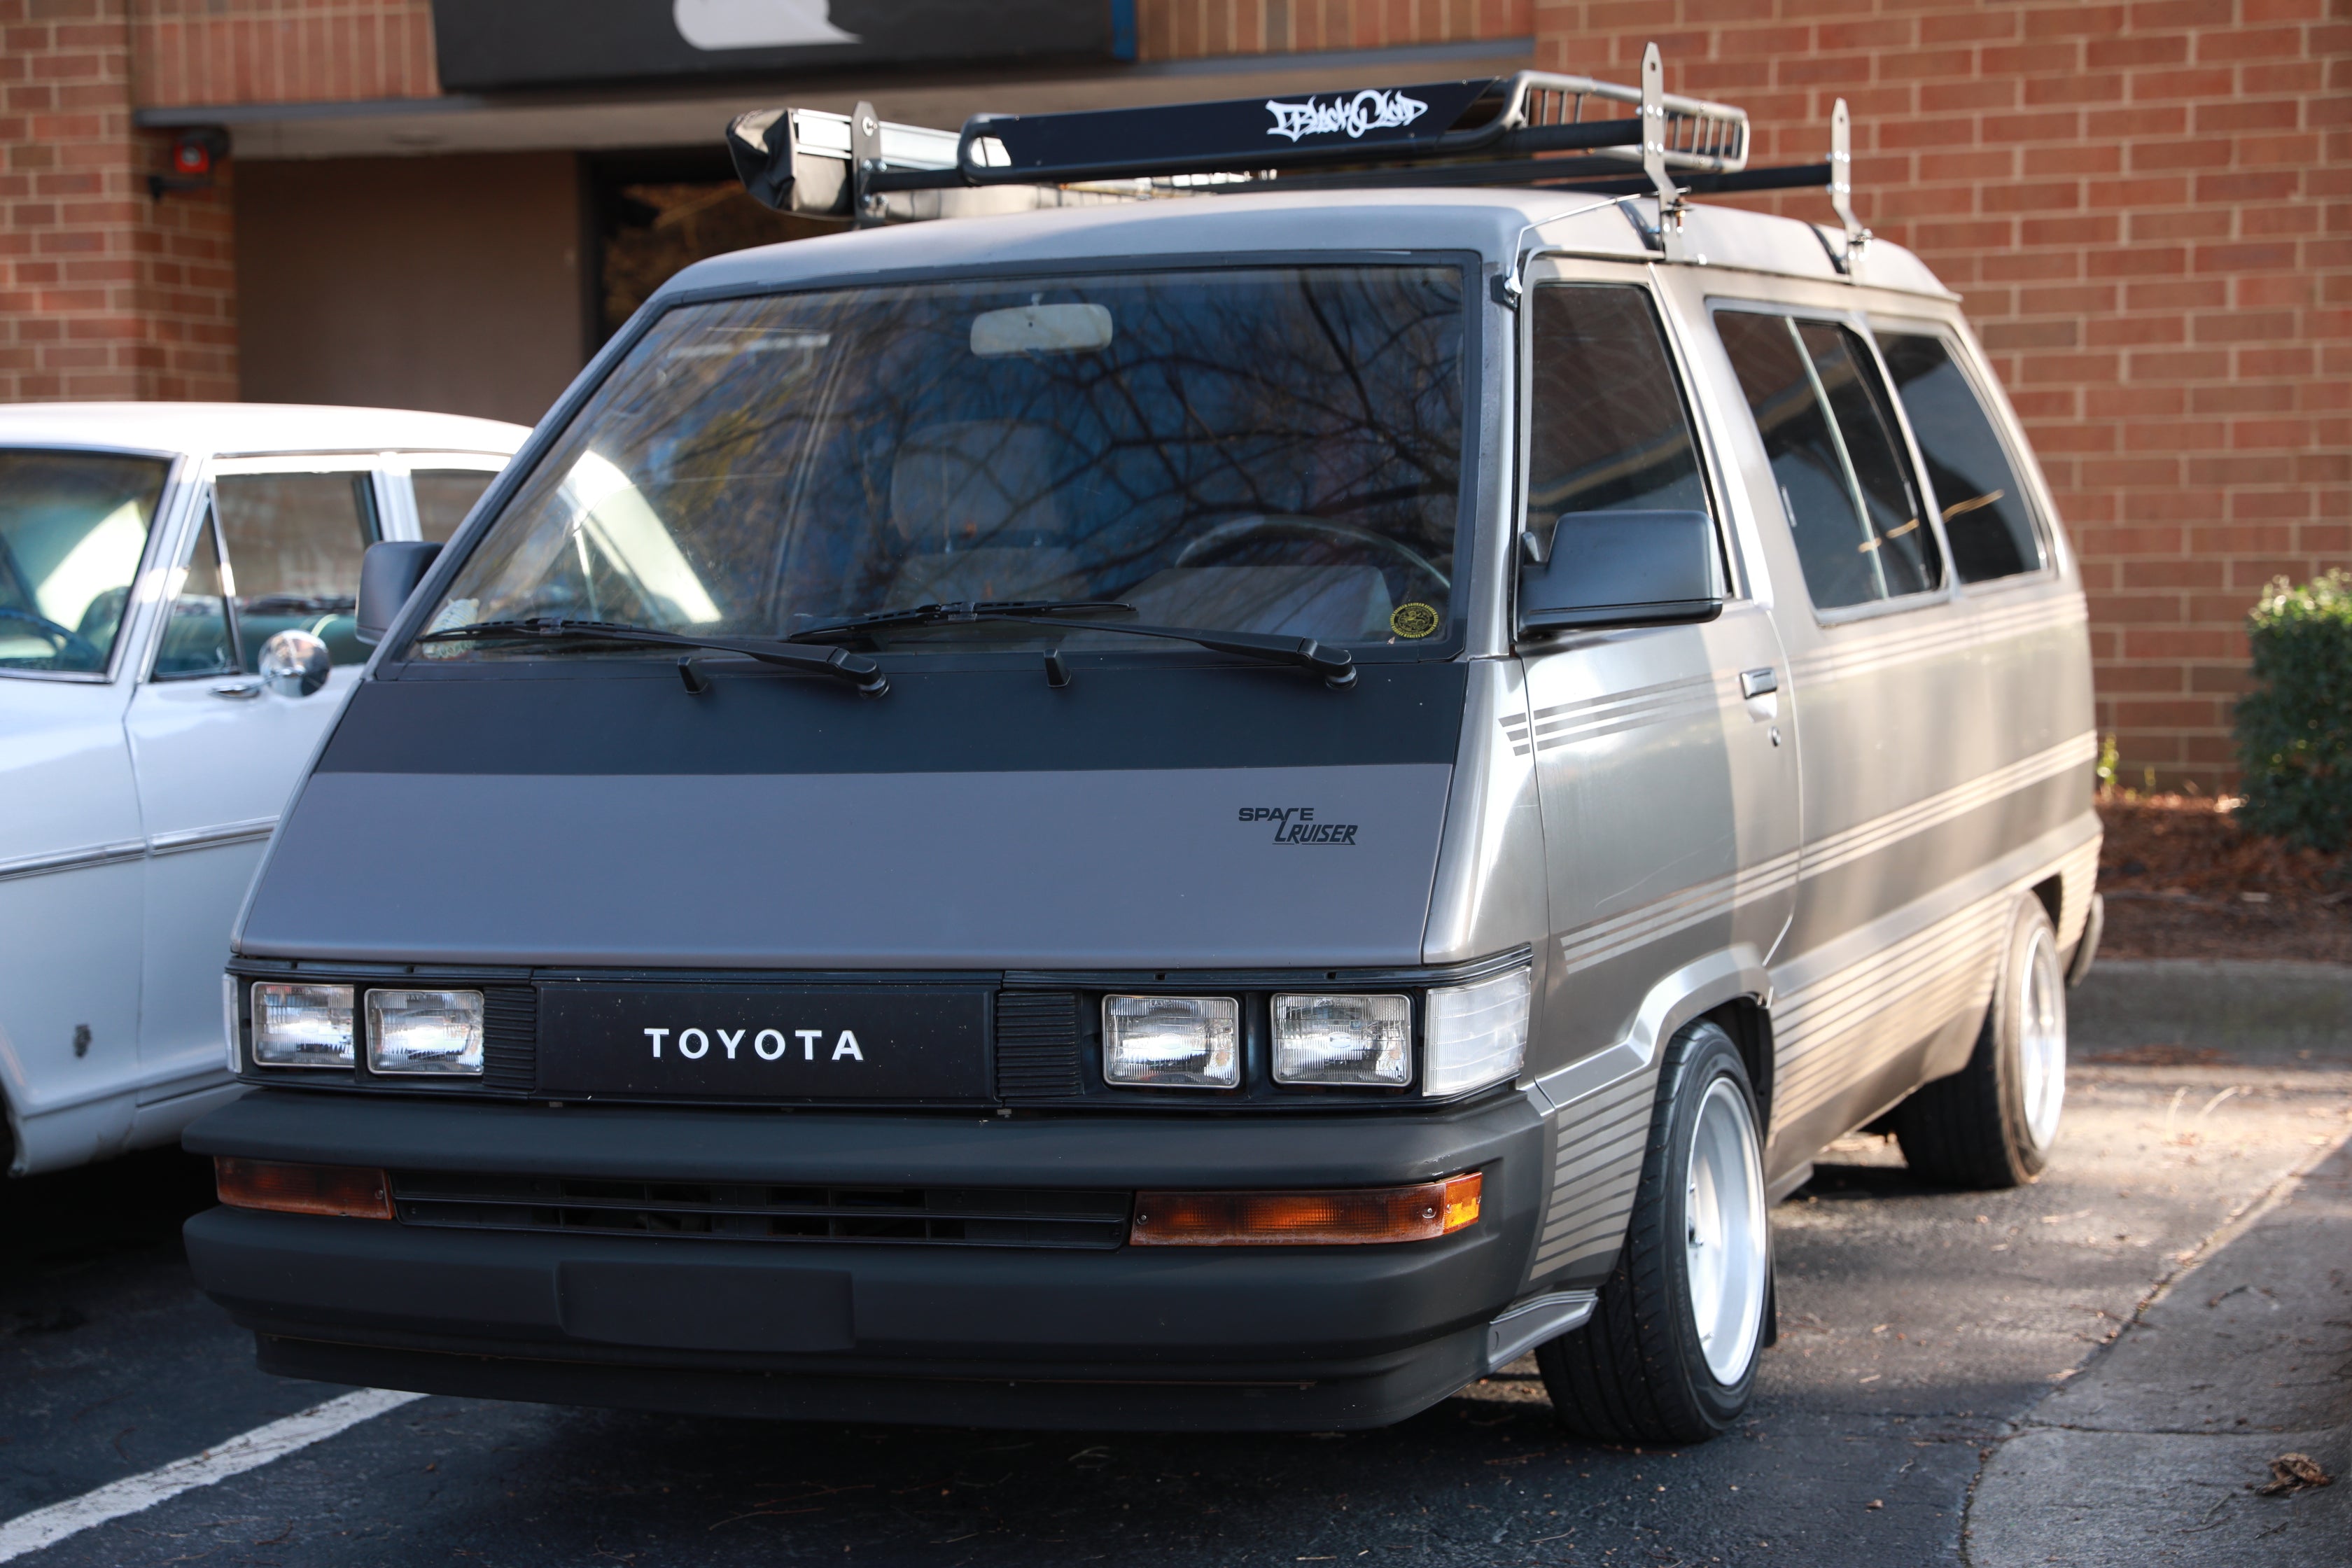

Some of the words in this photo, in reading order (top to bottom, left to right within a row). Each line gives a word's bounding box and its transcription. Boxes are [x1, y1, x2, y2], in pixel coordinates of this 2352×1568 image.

[1238, 807, 1315, 822] SPACE
[1272, 818, 1358, 845] CRUISER
[644, 1028, 864, 1060] TOYOTA
